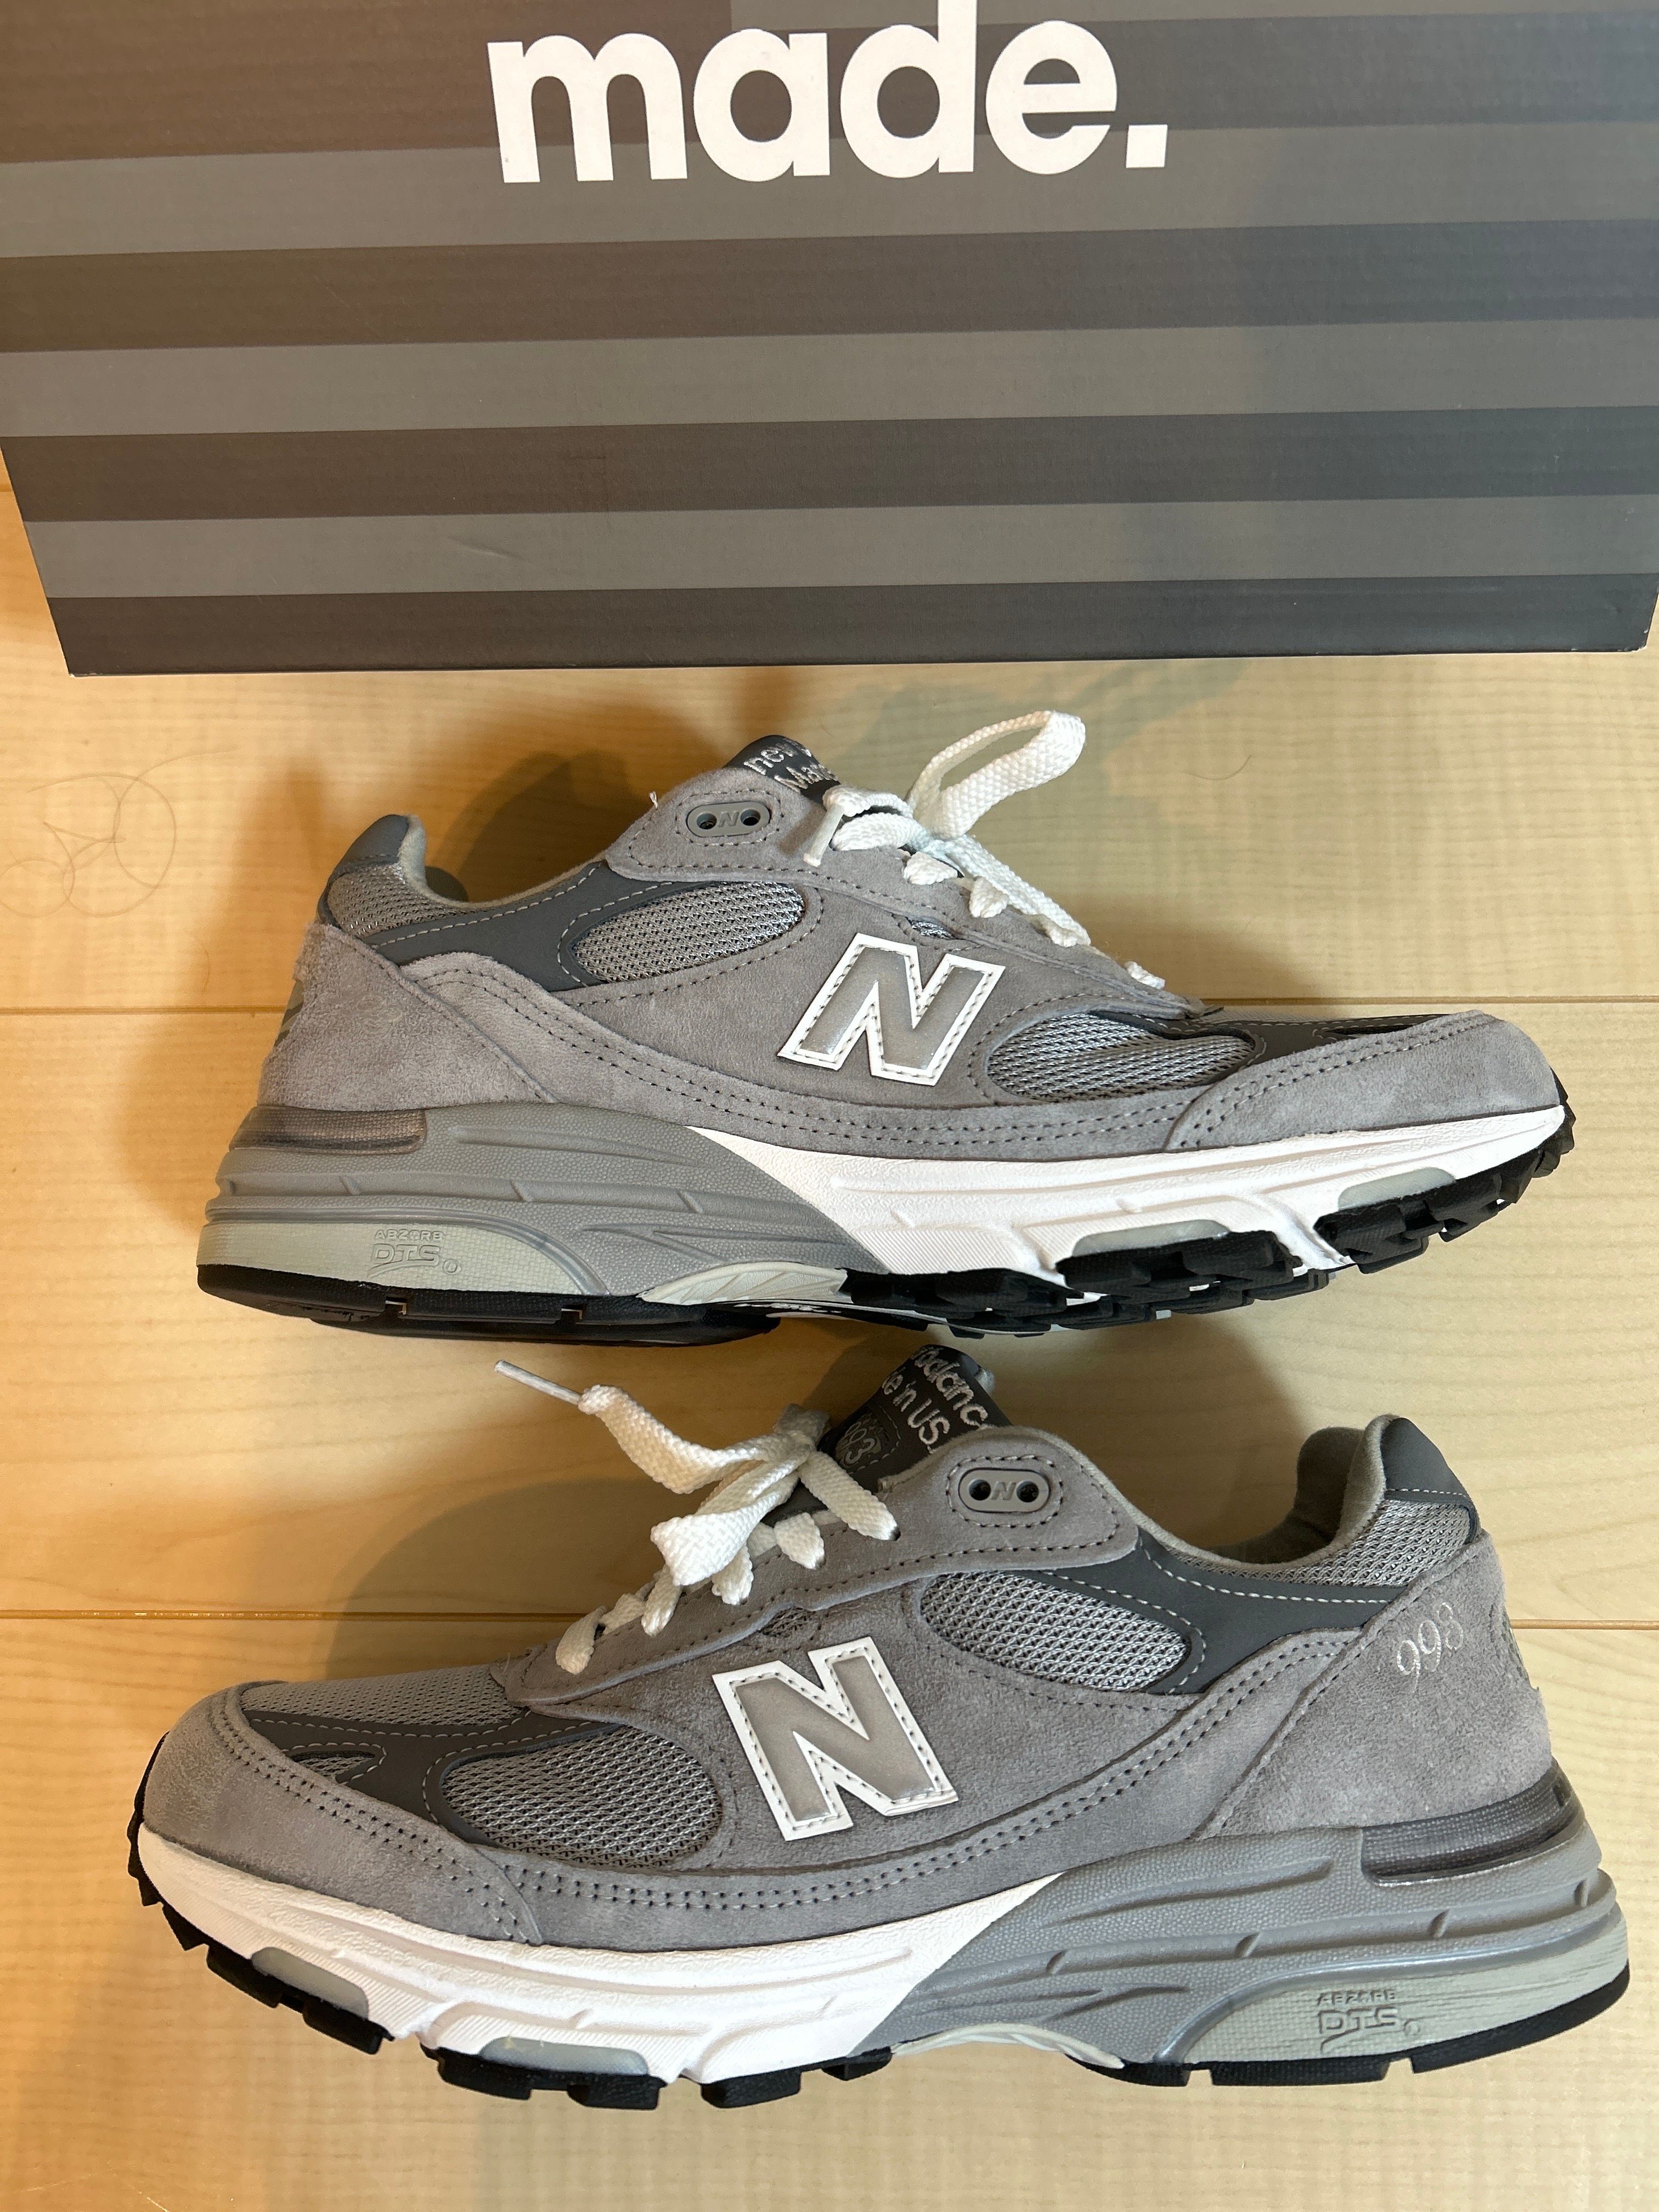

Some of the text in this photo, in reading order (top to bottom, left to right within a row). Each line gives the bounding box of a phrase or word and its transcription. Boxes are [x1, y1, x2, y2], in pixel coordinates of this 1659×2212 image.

[487, 0, 1169, 183] made.
[777, 933, 1006, 1086] N
[370, 1243, 441, 1267] DTS
[907, 1398, 951, 1447] US
[914, 1349, 992, 1430] balanc
[712, 1637, 959, 1841] N
